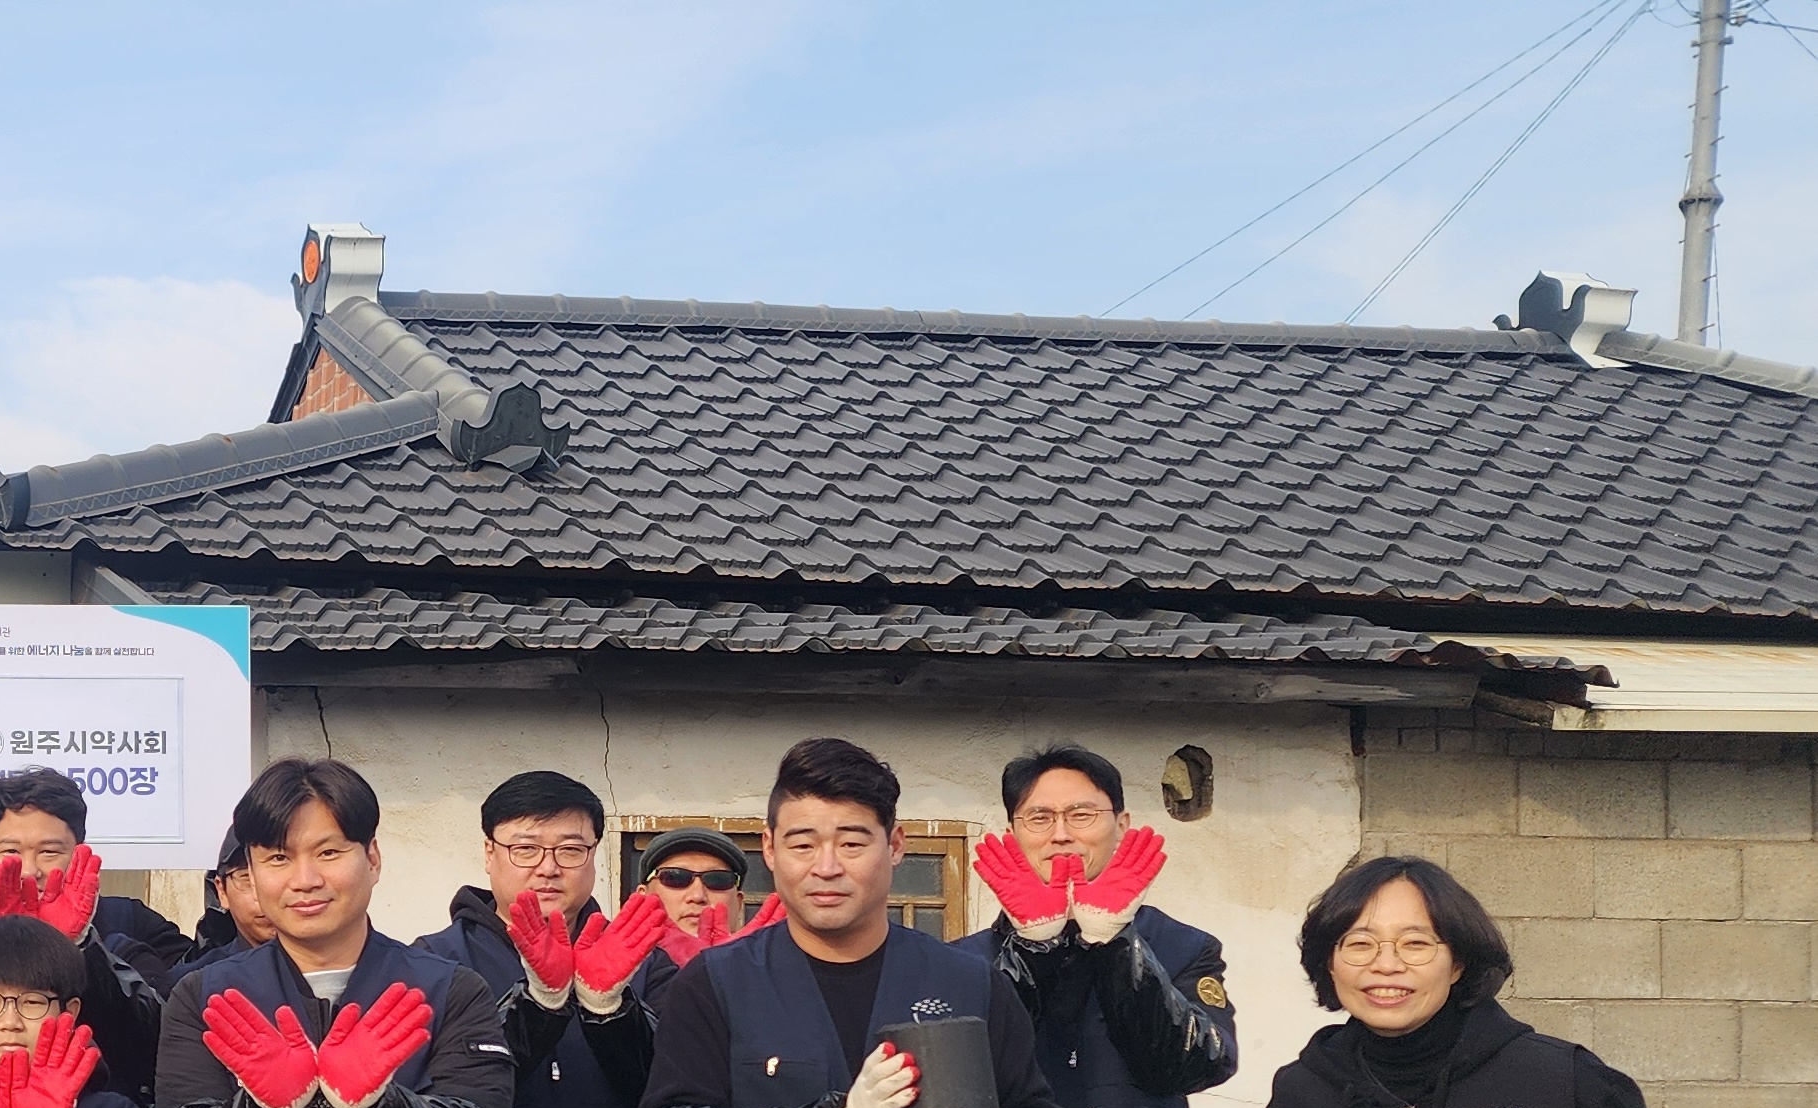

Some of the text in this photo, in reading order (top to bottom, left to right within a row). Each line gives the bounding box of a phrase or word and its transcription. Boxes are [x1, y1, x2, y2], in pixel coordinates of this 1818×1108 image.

[7, 646, 25, 656] 위한
[27, 644, 60, 656] 에너지
[9, 730, 167, 755] 원주시약사회
[42, 766, 159, 796] 500장
